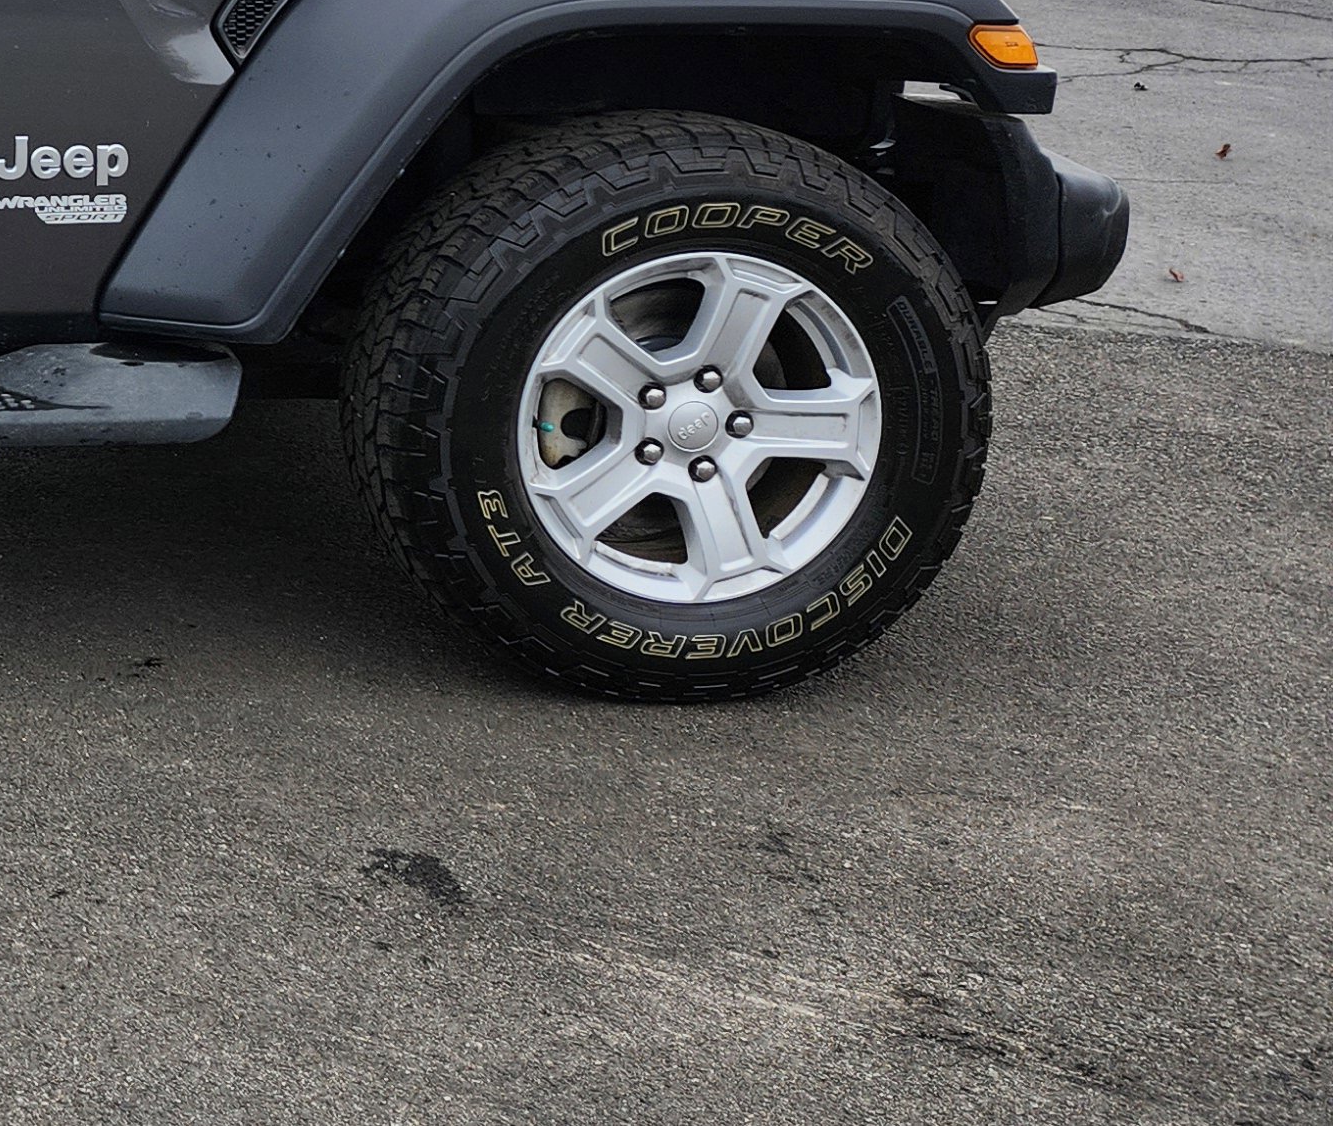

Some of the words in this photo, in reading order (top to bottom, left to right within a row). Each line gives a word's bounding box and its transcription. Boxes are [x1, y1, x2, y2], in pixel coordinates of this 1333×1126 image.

[35, 205, 127, 213] UNLIMITED
[44, 213, 121, 222] SPORT
[600, 202, 875, 274] COOPER
[477, 489, 552, 587] AT3
[559, 516, 913, 660] DISCOVERER
